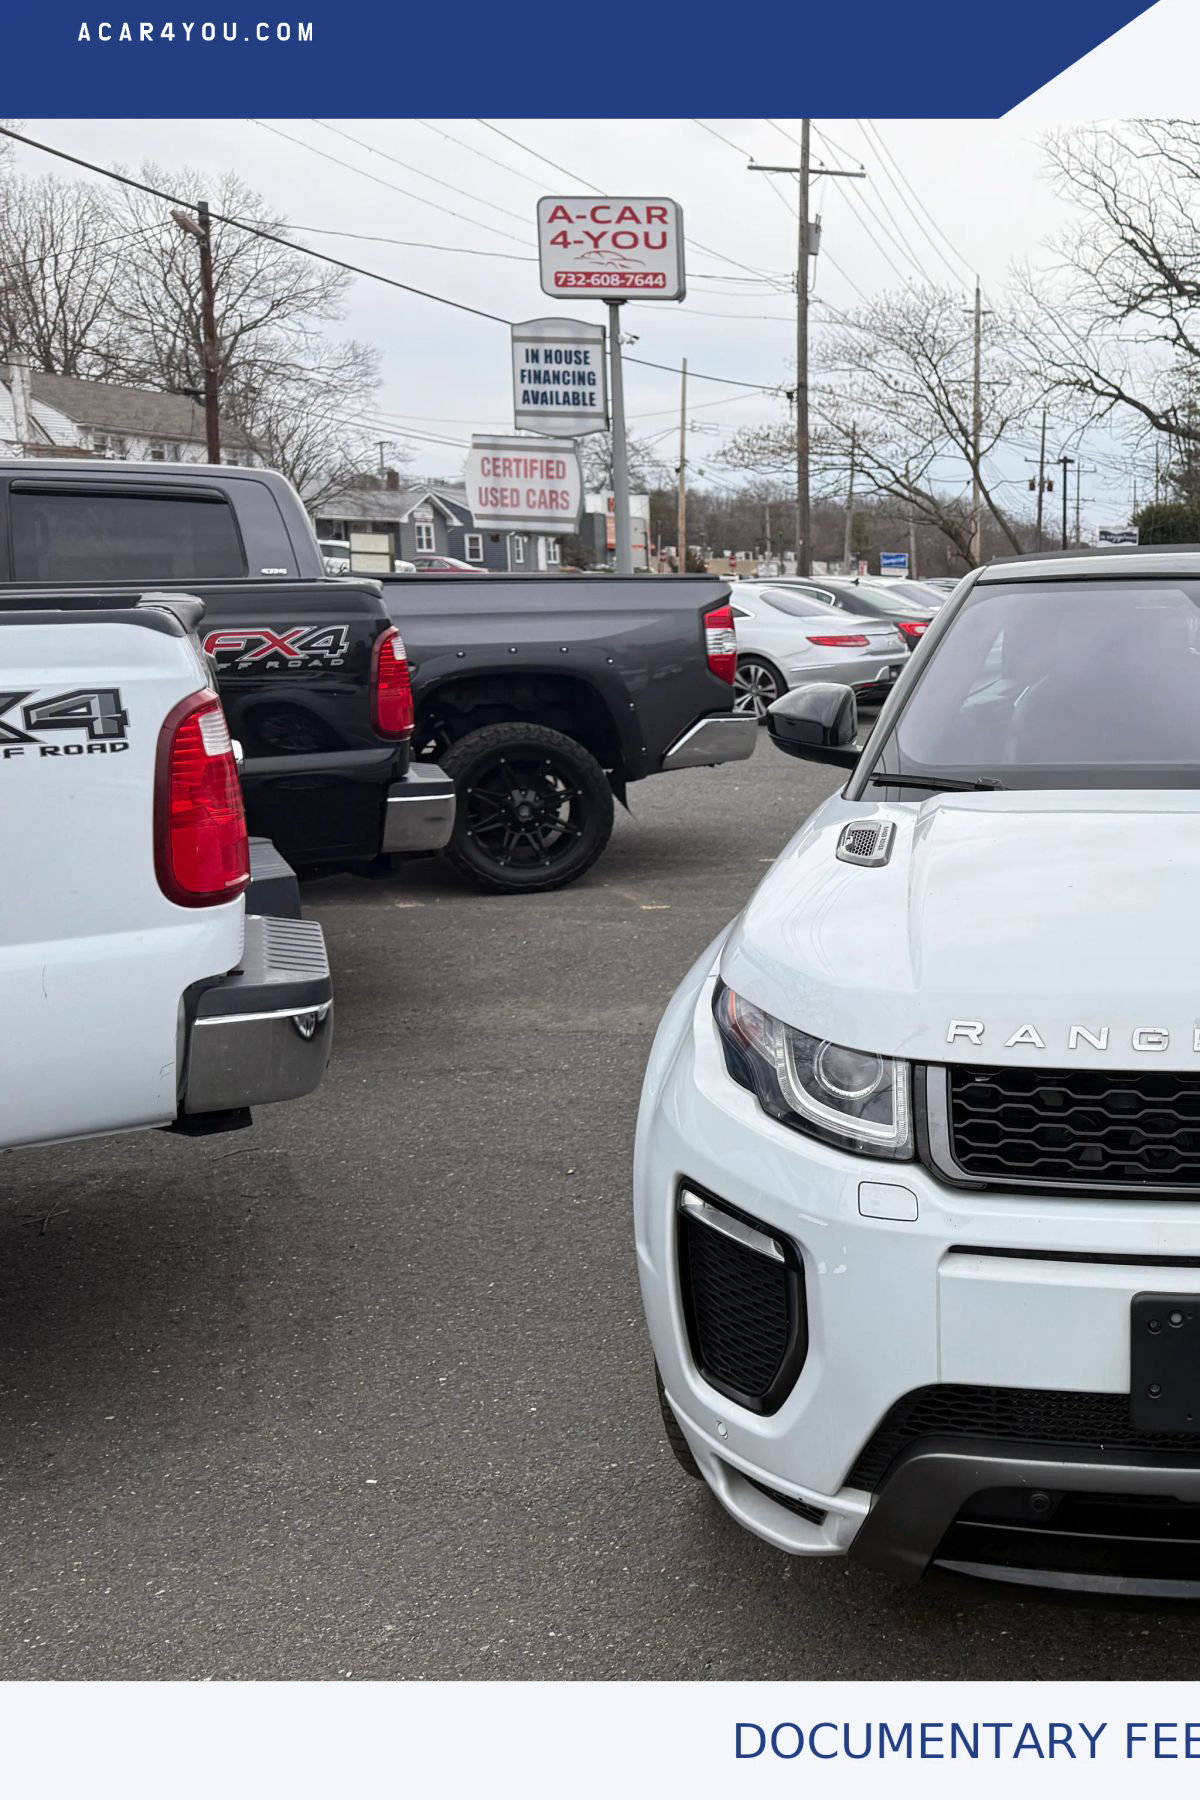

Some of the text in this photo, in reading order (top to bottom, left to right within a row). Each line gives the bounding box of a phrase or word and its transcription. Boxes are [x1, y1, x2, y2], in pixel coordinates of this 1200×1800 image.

[547, 204, 669, 225] A-CAR
[549, 229, 668, 250] 4-YOU
[556, 273, 665, 287] 732-608-7644
[525, 347, 591, 366] IN HOUSE
[520, 368, 597, 386] FINANCING
[522, 389, 597, 407] AVAILABLE
[480, 456, 567, 480] CERTIFIED
[478, 486, 571, 511] USED CARS
[202, 624, 350, 662] FX4
[265, 658, 345, 669] ROAD
[39, 742, 130, 758] ROAD
